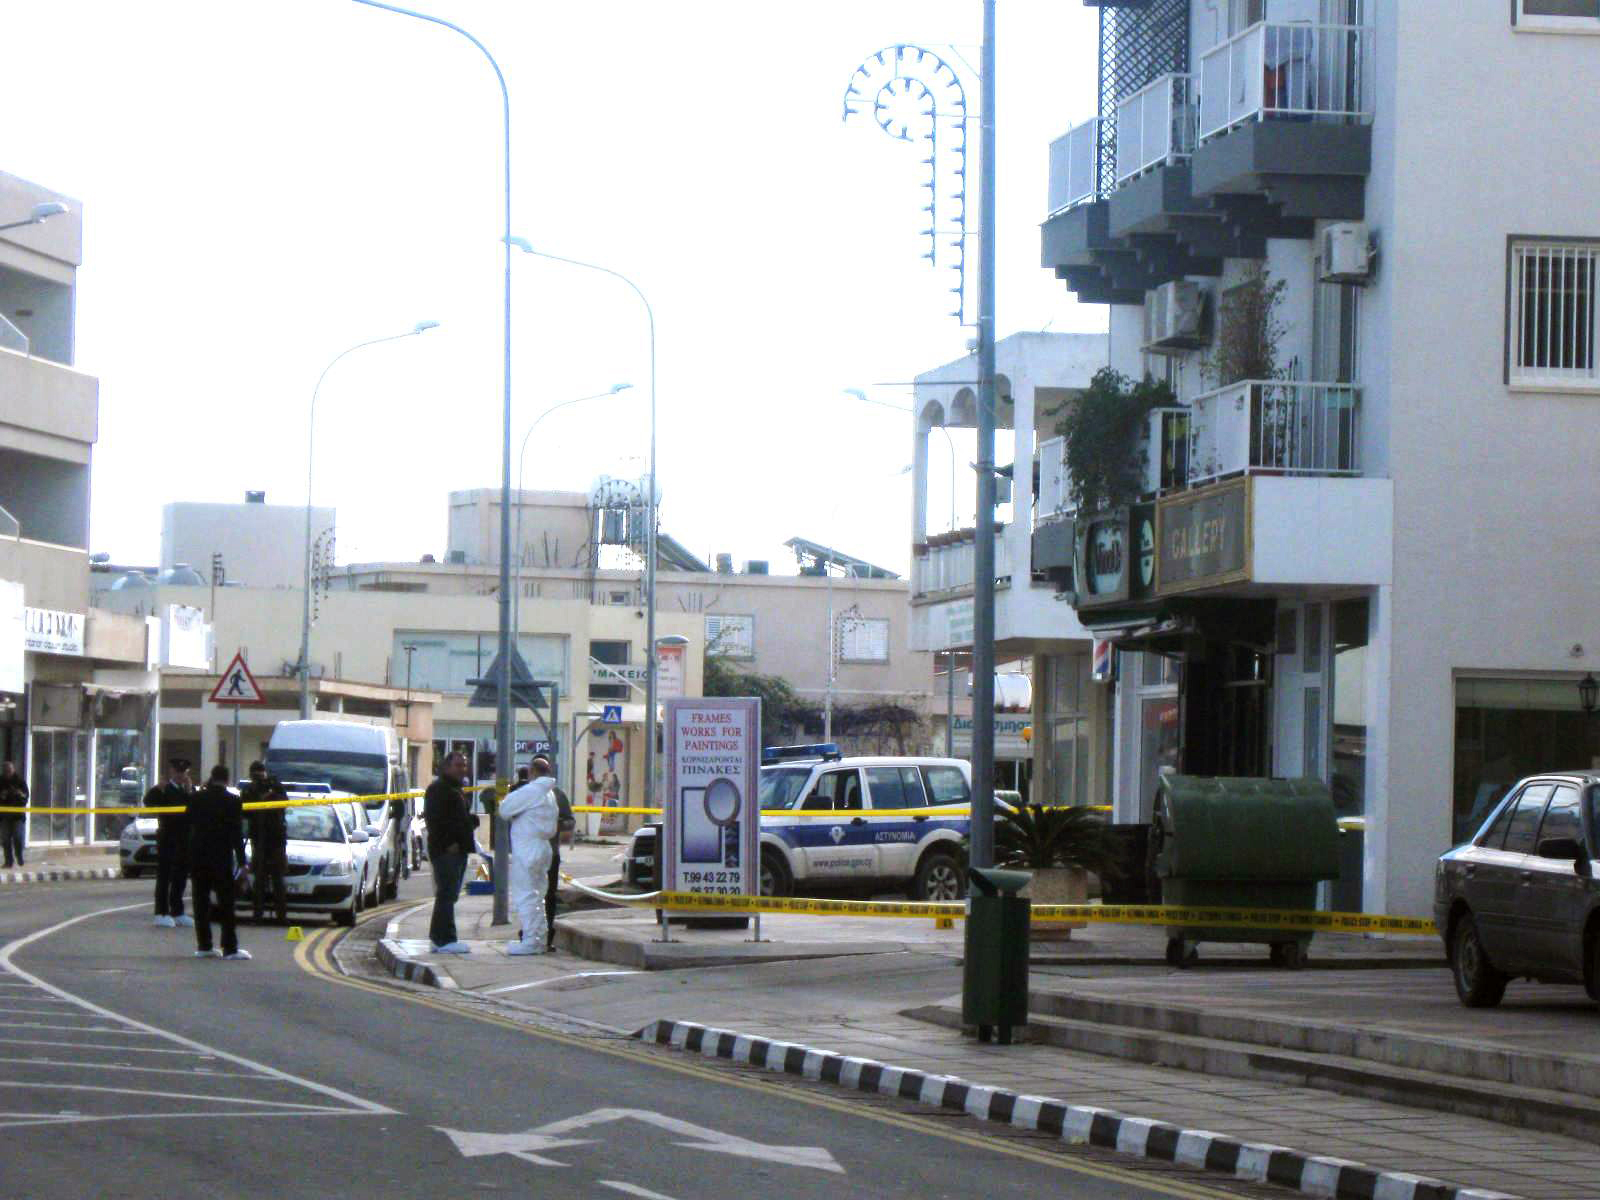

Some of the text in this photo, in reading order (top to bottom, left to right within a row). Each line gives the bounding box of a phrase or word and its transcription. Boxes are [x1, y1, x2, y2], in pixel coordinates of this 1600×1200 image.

[593, 669, 648, 678] ΜΑΚΕΙΟ
[691, 713, 732, 724] FRAMES
[681, 726, 742, 737] WORKS FOR
[684, 740, 738, 751] PAINTINGS
[682, 765, 741, 775] ΠΙΝΑΚΕΣ
[875, 831, 916, 841] ΑΣΤΥΝΟΜΙΑ
[716, 872, 727, 883] 22
[729, 872, 740, 883] 79
